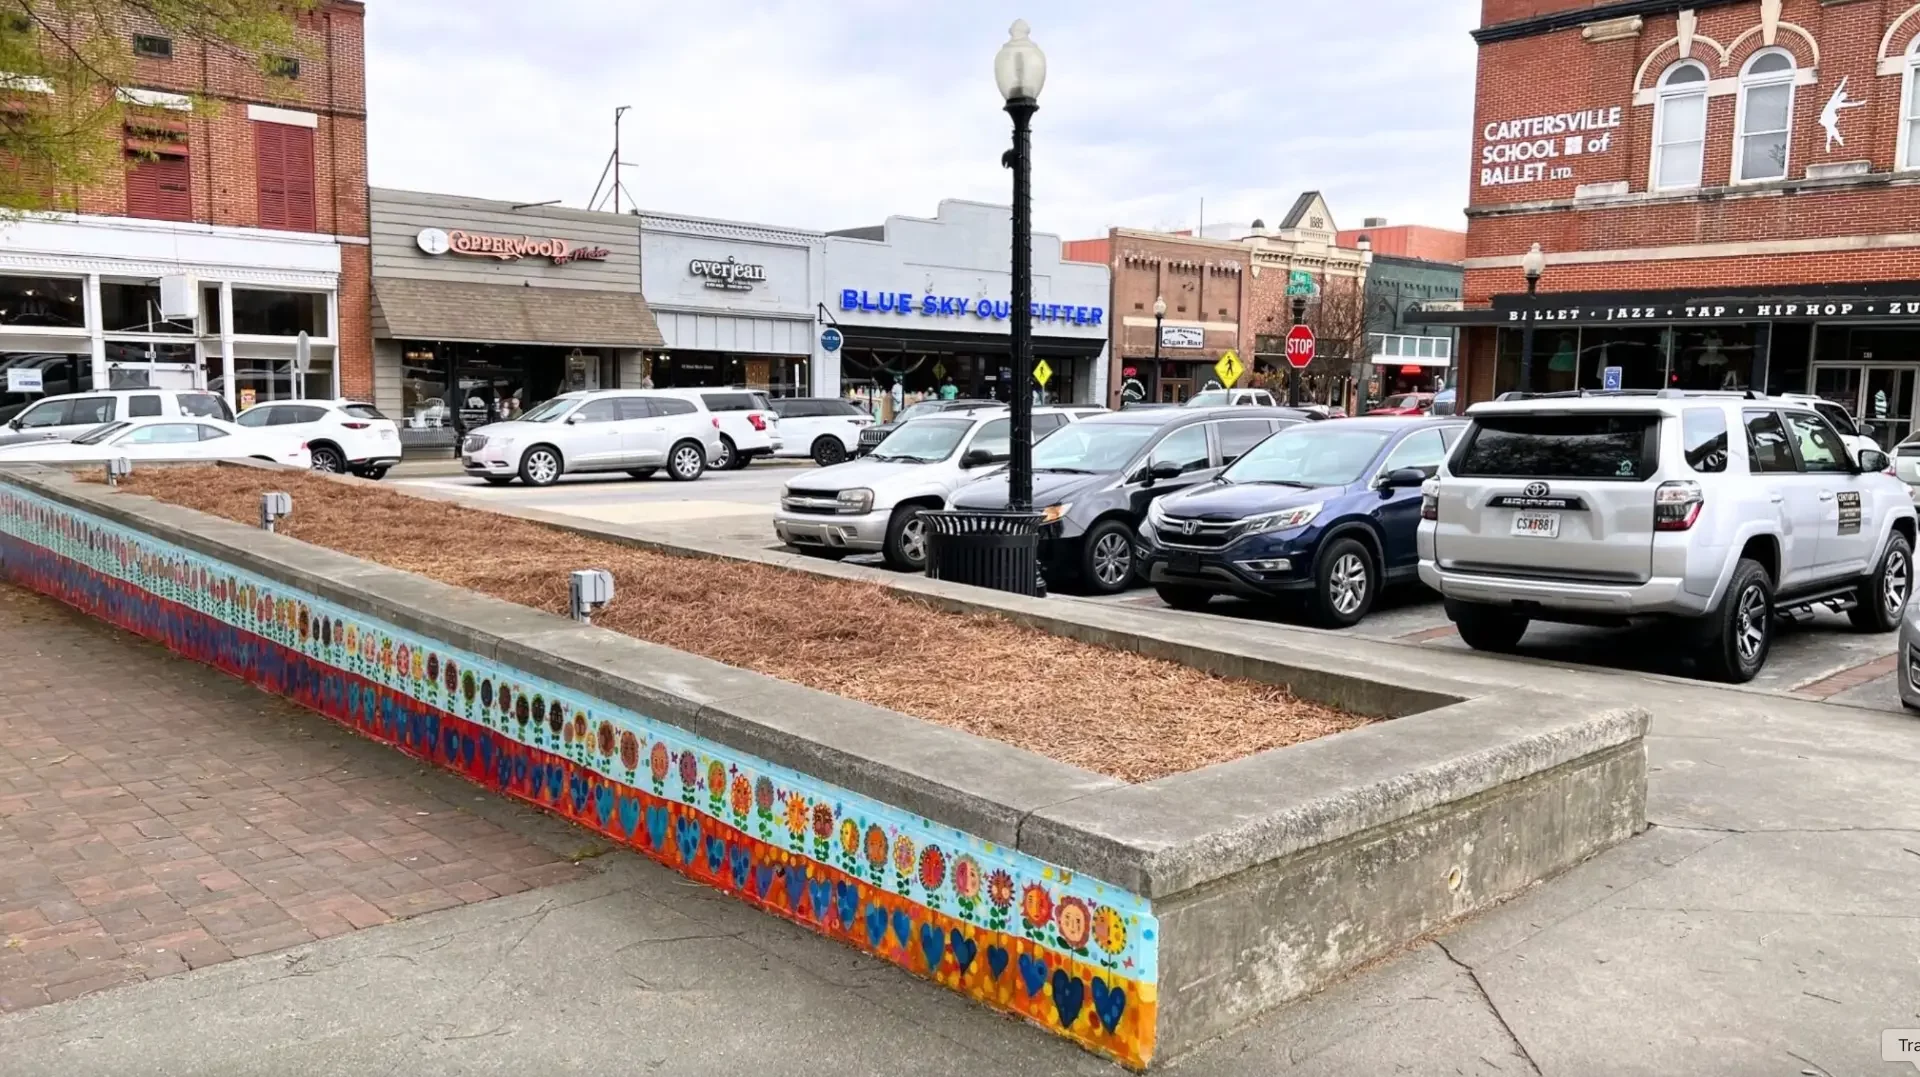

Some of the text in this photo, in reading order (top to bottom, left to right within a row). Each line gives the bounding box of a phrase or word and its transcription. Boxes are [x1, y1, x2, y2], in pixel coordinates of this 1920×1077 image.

[1484, 107, 1621, 141] CARTERSVILLE
[1482, 132, 1610, 164] SCHOOL of
[1480, 162, 1573, 186] BALLET LTD.
[449, 230, 569, 259] COPPERWOOD
[691, 257, 765, 282] everjean
[842, 289, 1103, 324] BLUE SKY OUFITTER
[1607, 308, 1655, 321] JAZZ
[1685, 306, 1726, 317] TAP
[1757, 304, 1797, 316] HIP
[1806, 303, 1853, 316] HOP
[1889, 302, 1920, 314] ZU
[1287, 338, 1313, 354] STOP
